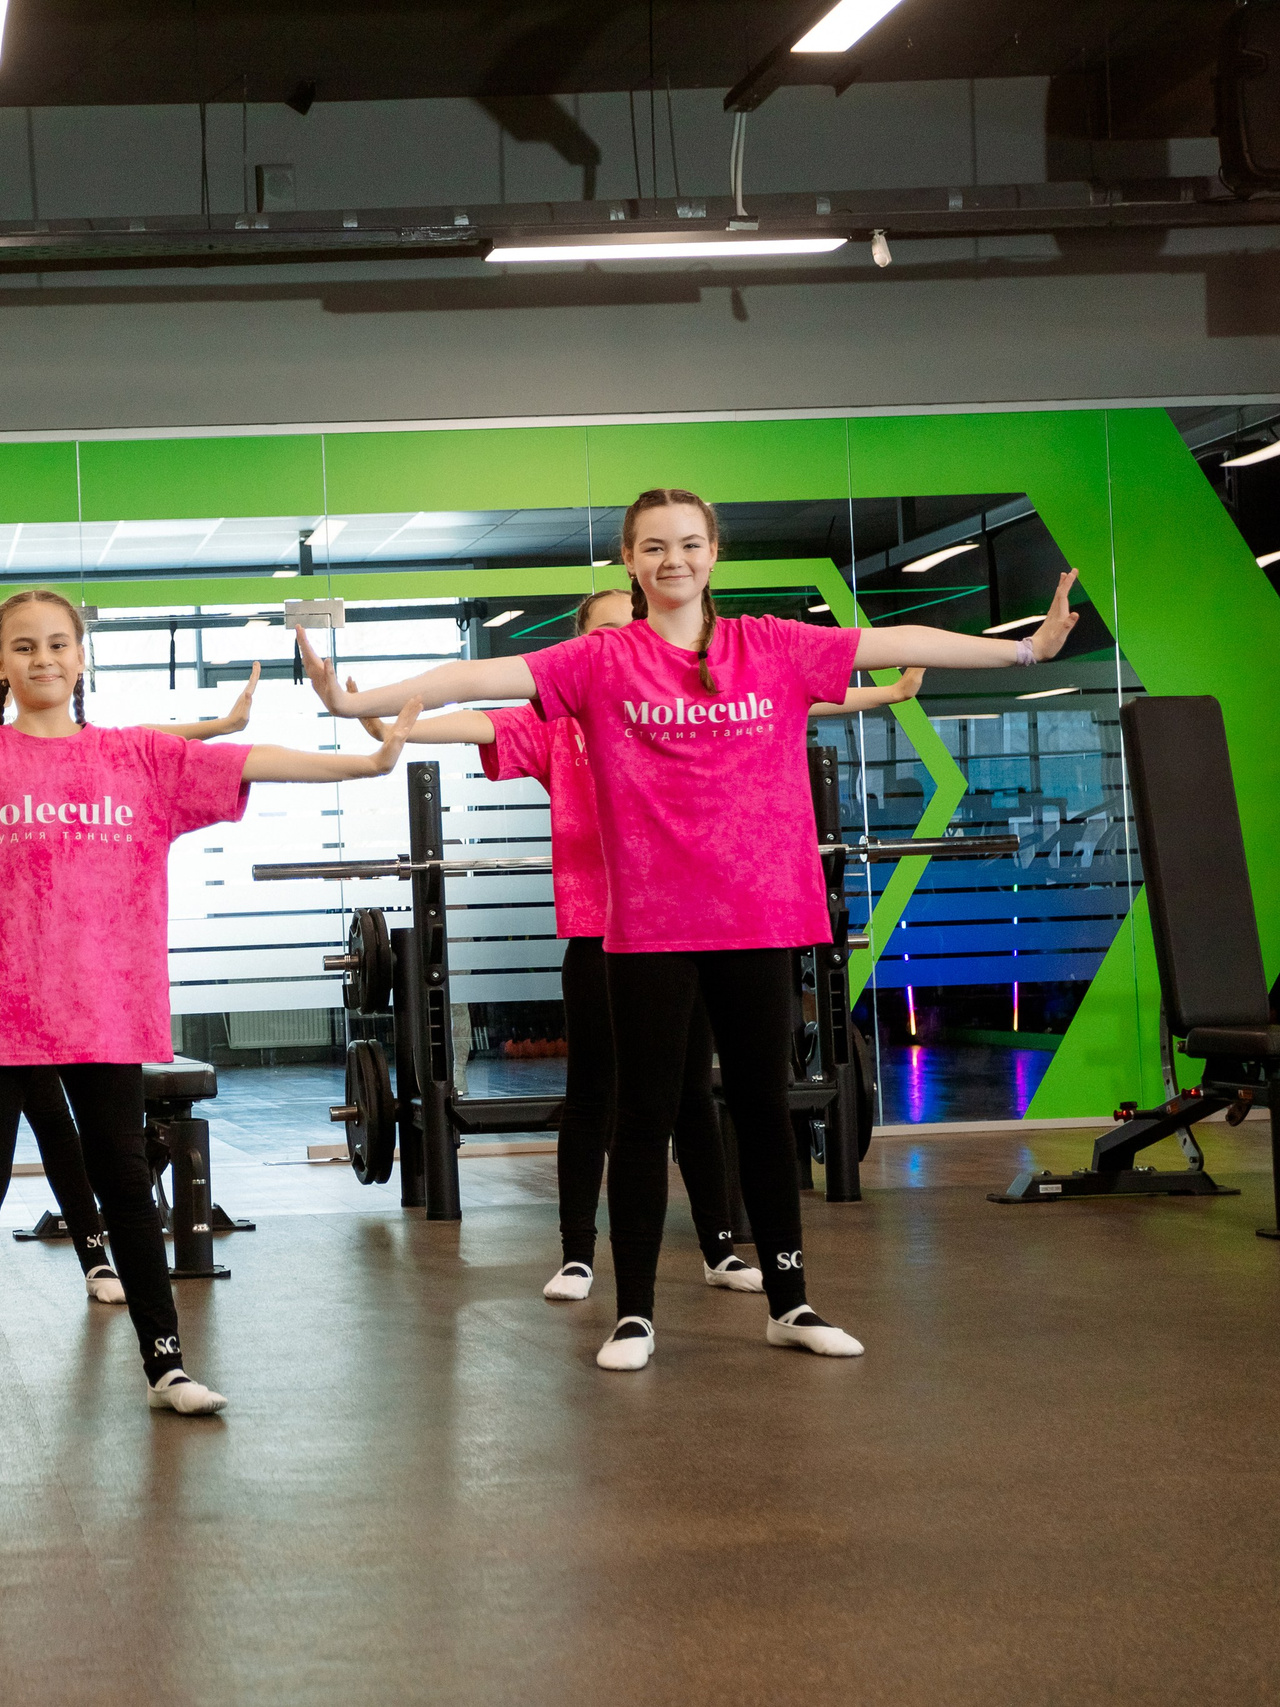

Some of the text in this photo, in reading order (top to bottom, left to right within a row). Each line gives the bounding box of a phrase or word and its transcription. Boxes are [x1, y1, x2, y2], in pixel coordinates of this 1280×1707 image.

[622, 692, 774, 725] Molecule
[624, 723, 775, 741] Студия танцев
[62, 831, 133, 843] танцев
[776, 1250, 803, 1271] SC
[154, 1335, 180, 1358] SC
